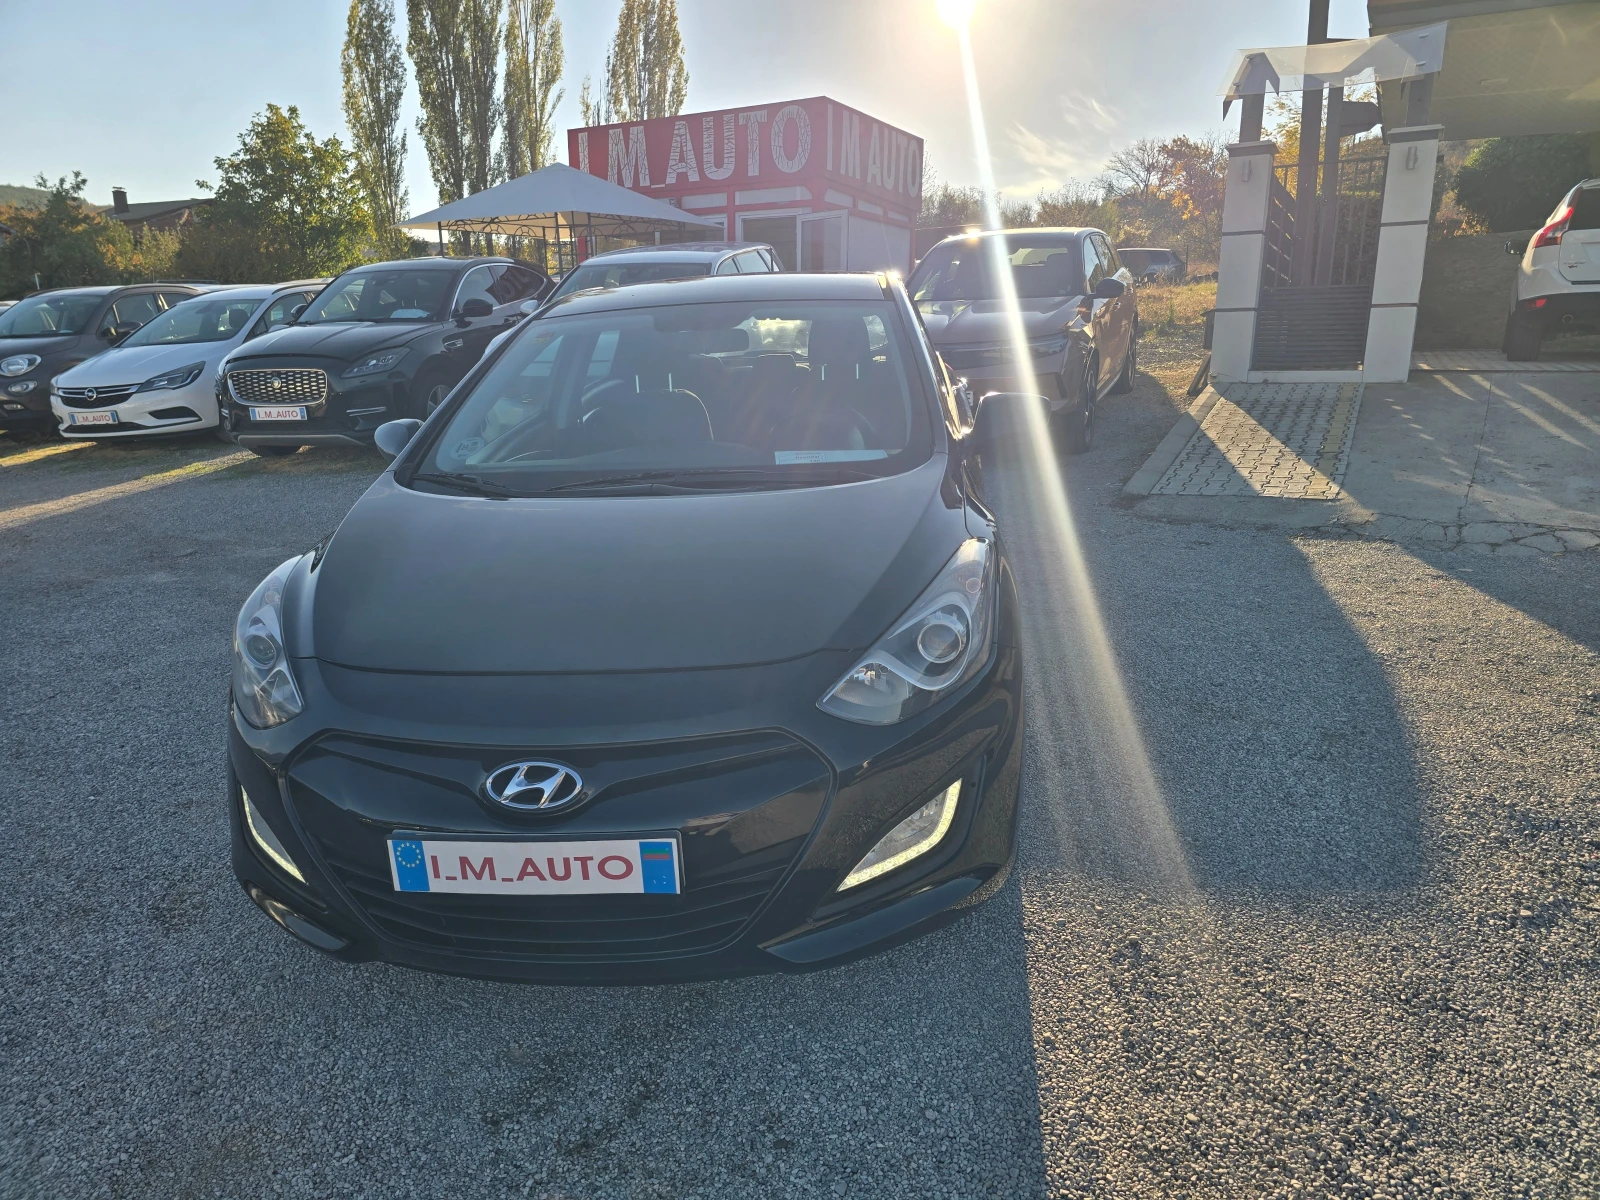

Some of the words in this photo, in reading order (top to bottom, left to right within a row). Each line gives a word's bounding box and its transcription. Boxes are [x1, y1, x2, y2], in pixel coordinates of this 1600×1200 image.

[840, 109, 861, 180] M
[866, 122, 920, 198] AUTO
[430, 855, 634, 883] I_M_AUTO
